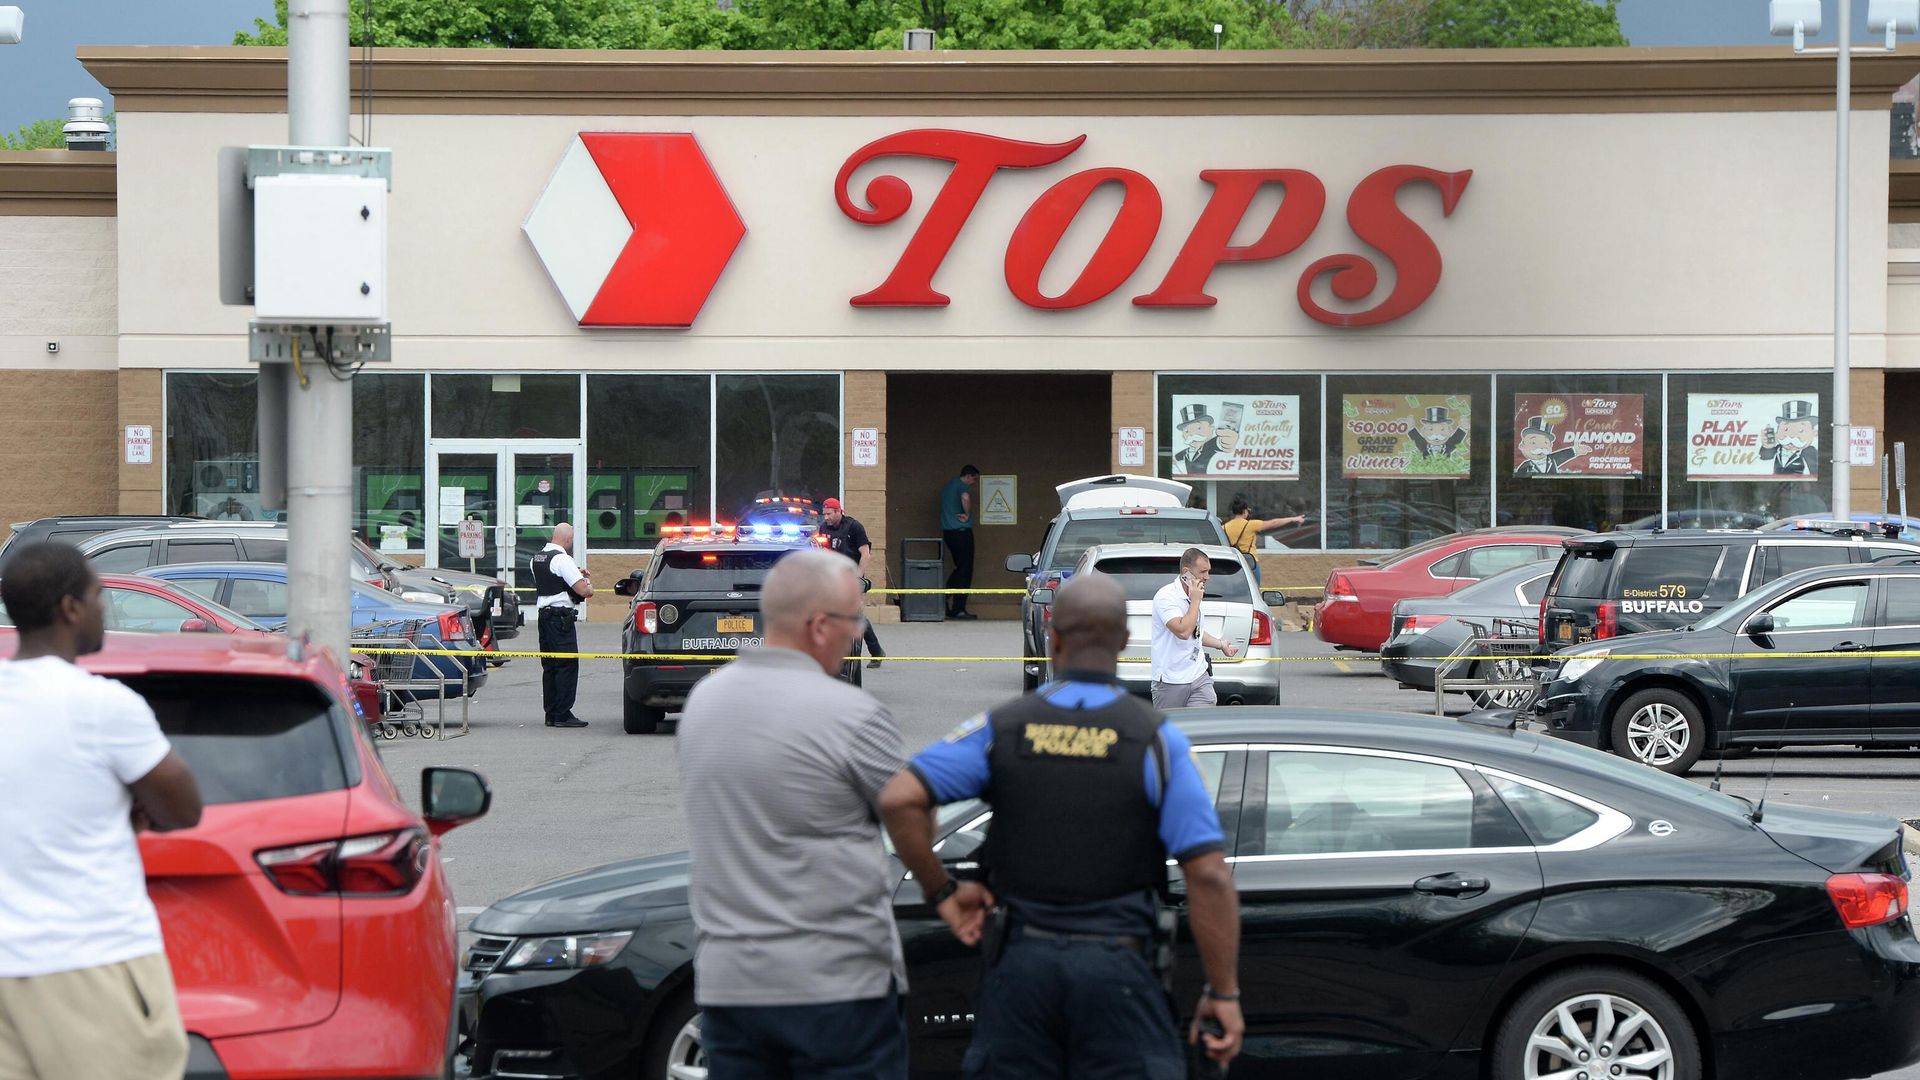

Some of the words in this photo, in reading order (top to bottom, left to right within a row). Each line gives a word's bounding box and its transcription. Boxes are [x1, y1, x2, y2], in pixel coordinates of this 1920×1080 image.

[834, 128, 1474, 328] TOPS
[1546, 405, 1561, 414] 60
[1245, 420, 1293, 437] instantly
[1349, 421, 1408, 434] $60,000
[1701, 421, 1748, 432] PLAY
[1244, 434, 1279, 446] win
[1358, 437, 1398, 445] GRAND
[1563, 432, 1636, 443] DIAMOND
[1692, 434, 1758, 446] ONLINE
[1233, 449, 1294, 458] MILLIONS
[1603, 443, 1632, 457] free
[1347, 456, 1409, 469] winner
[1713, 449, 1758, 464] win
[1216, 461, 1235, 470] OF
[1239, 461, 1294, 470] PRIZES!
[1623, 589, 1658, 597] E-District
[1659, 585, 1687, 598] 579
[1621, 600, 1704, 613] BUFFALO
[723, 620, 746, 630] POLICE
[682, 638, 739, 650] BUFFALO
[1025, 723, 1118, 745] BUFFALO
[1033, 737, 1108, 757] POLICE
